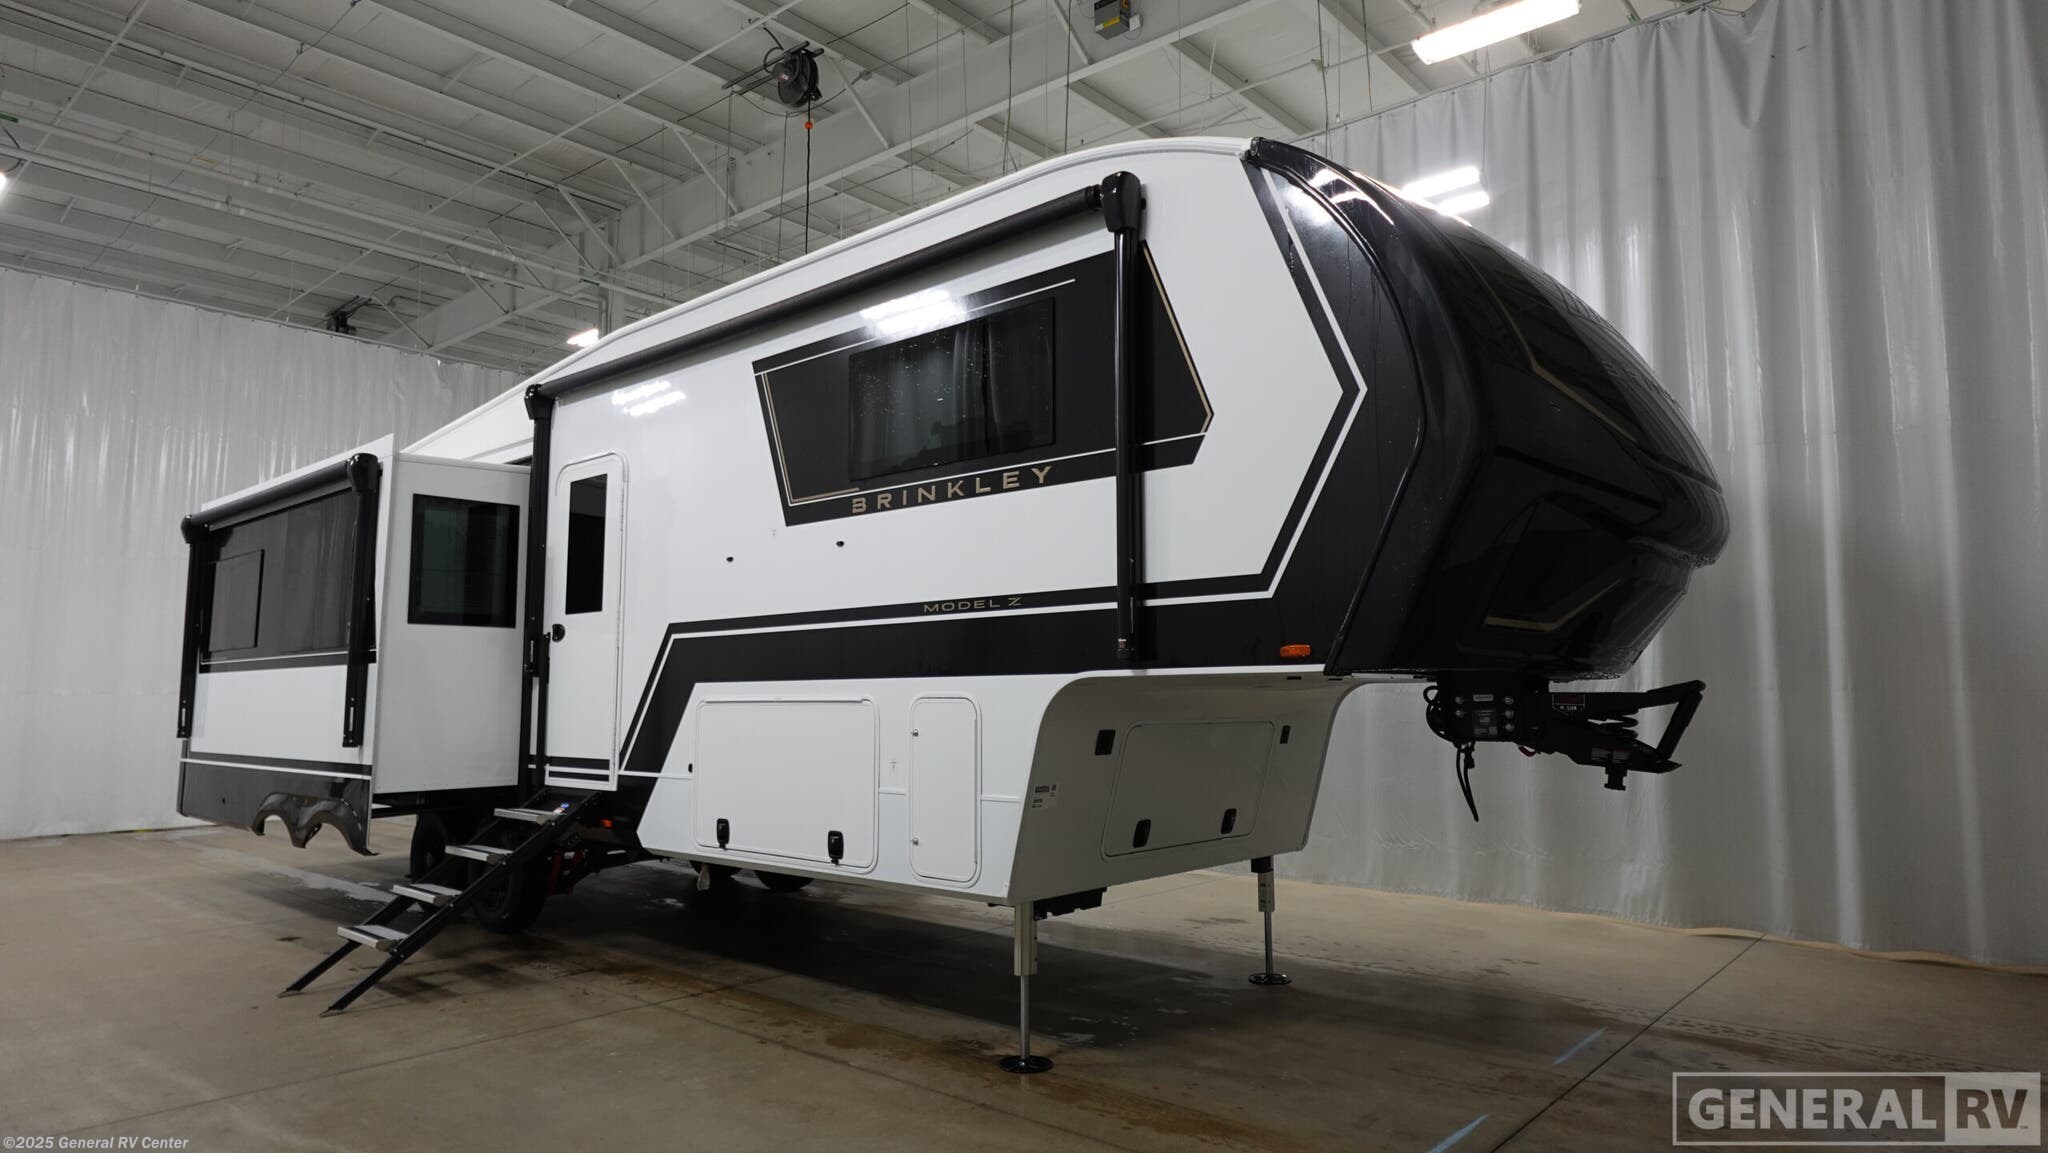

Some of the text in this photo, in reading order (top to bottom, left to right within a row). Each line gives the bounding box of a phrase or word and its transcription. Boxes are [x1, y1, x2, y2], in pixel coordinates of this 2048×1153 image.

[852, 466, 1052, 514] BRINKLEY
[923, 597, 1021, 613] MODEL Z
